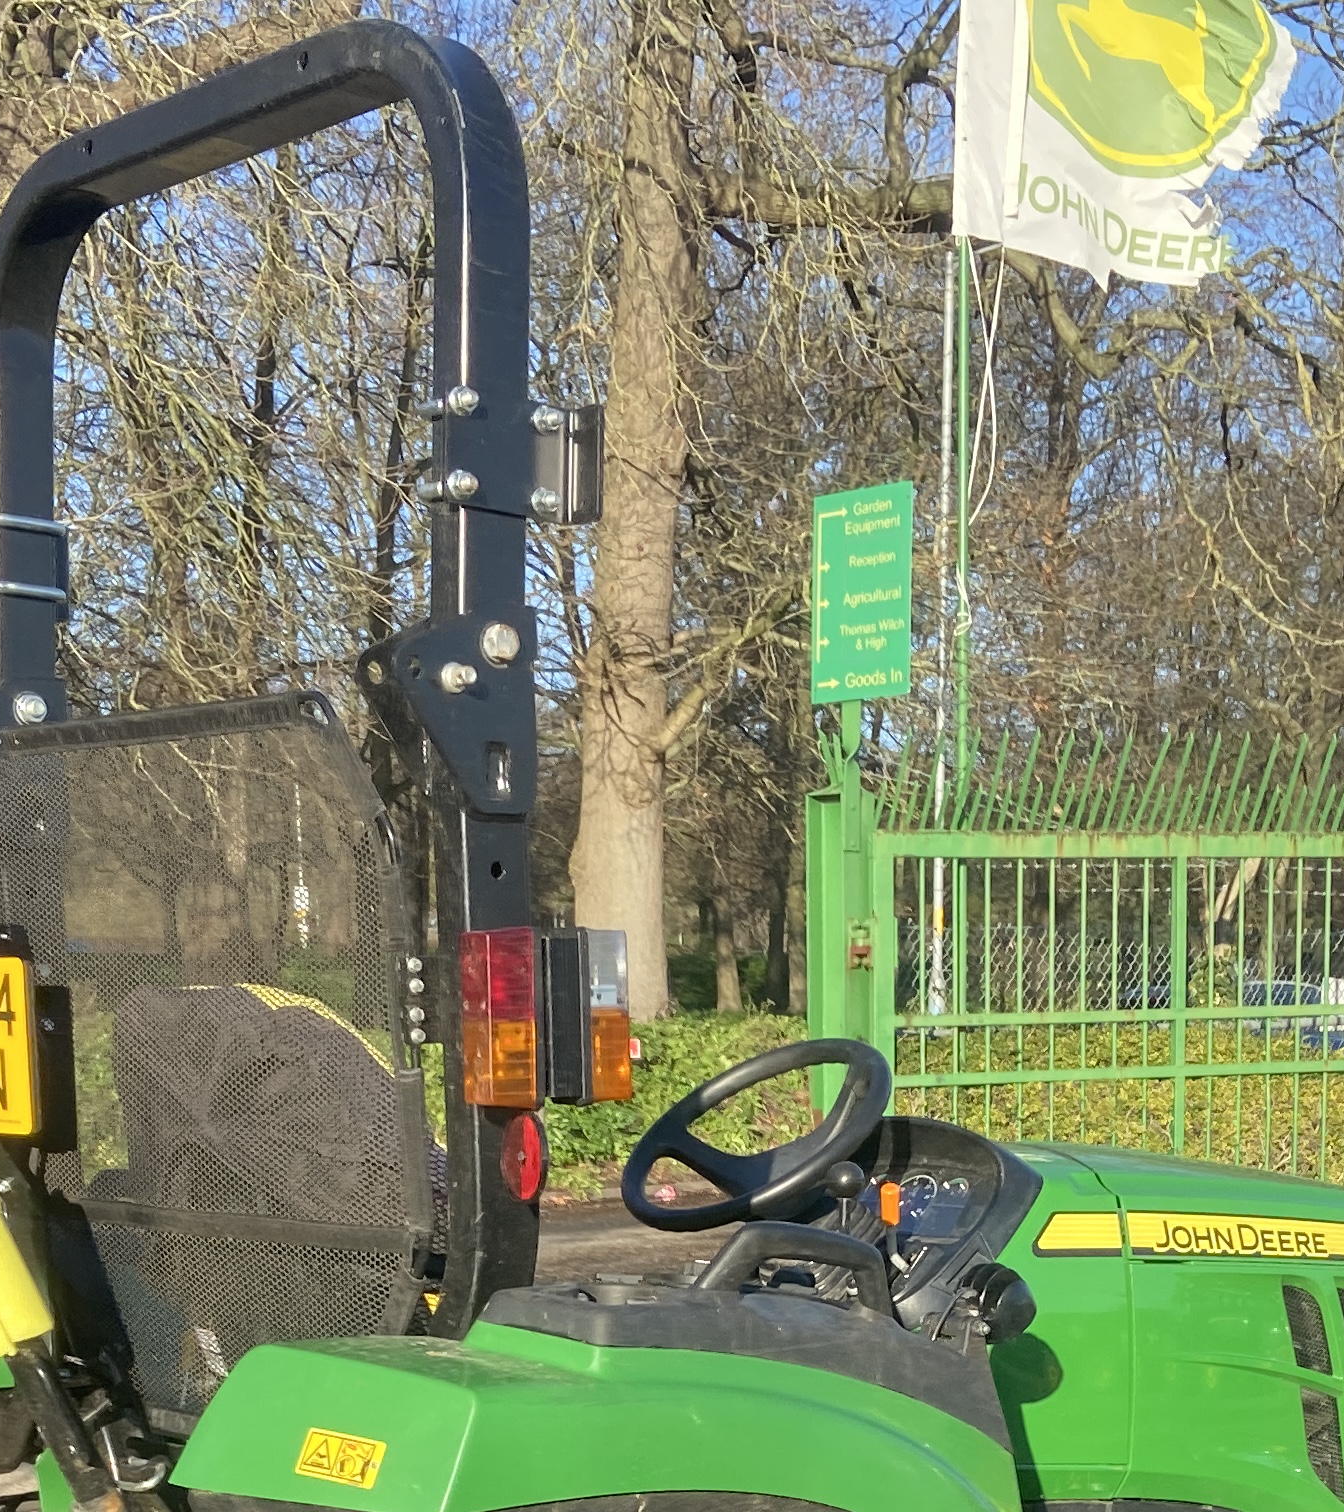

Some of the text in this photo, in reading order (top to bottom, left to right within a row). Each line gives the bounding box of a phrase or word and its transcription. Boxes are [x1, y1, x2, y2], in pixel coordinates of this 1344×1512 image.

[1018, 163, 1099, 242] JOHN
[853, 499, 893, 516] Garden
[844, 513, 901, 536] Equipment
[849, 551, 896, 568] Reception
[843, 585, 902, 608] Agricultural
[839, 623, 876, 637] Thomas
[855, 636, 887, 650] & High
[845, 666, 903, 688] Goods In
[1155, 1220, 1328, 1254] JOHN DEERE
